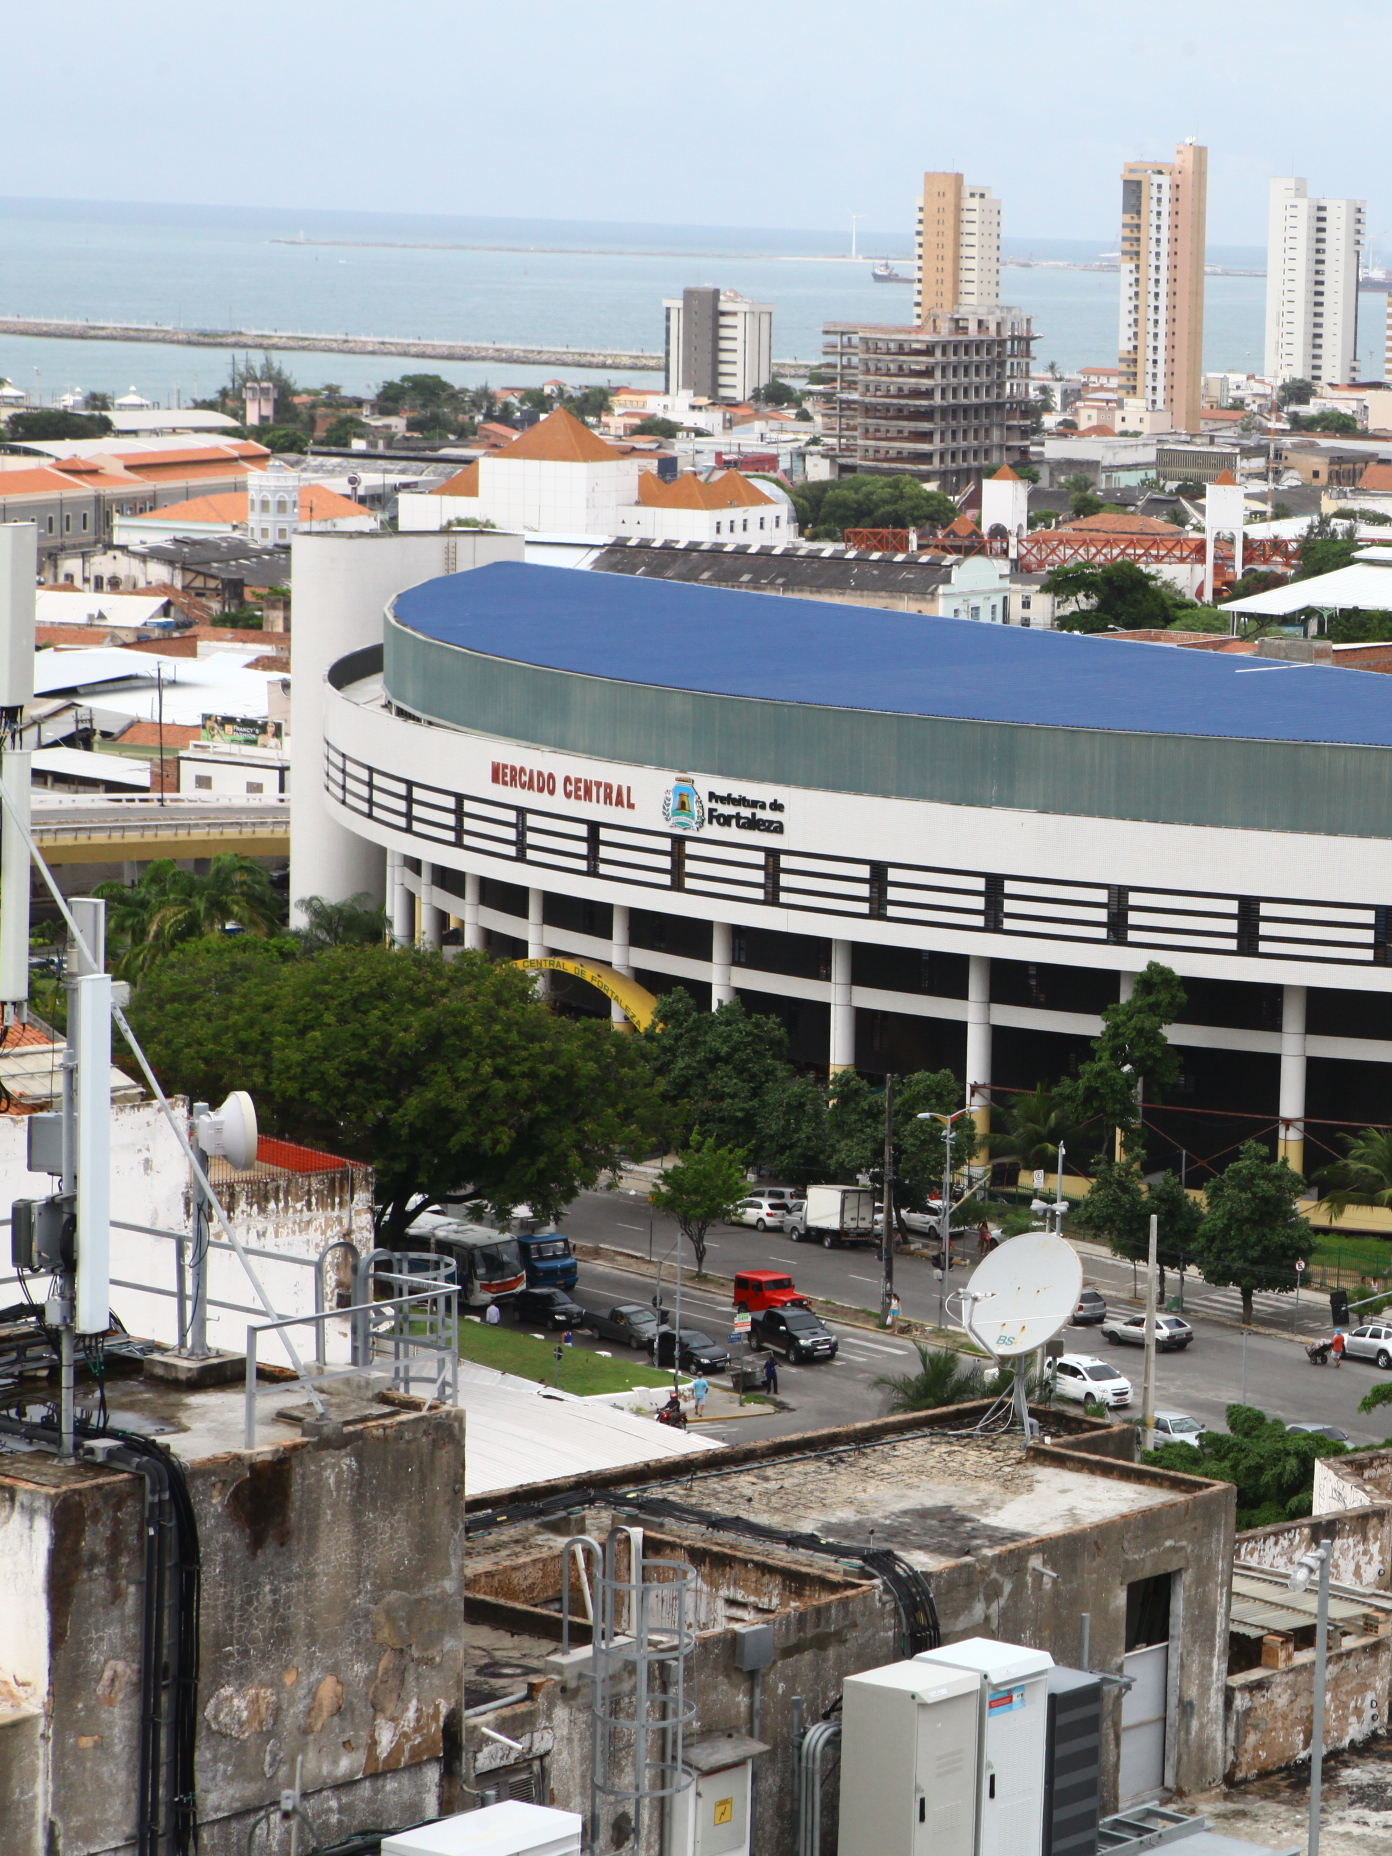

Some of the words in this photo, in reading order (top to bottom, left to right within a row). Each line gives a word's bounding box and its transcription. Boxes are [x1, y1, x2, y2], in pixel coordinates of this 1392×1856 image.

[233, 725, 260, 735] FRANCY'S
[491, 760, 556, 796] MERCADO
[563, 775, 635, 810] CENTRAL
[708, 791, 766, 810] Prefeitura
[769, 799, 785, 812] de
[708, 807, 784, 834] Fortaleza
[522, 959, 568, 971] CENTRAL
[574, 966, 586, 979] DE
[591, 975, 641, 1026] FORTALEZA
